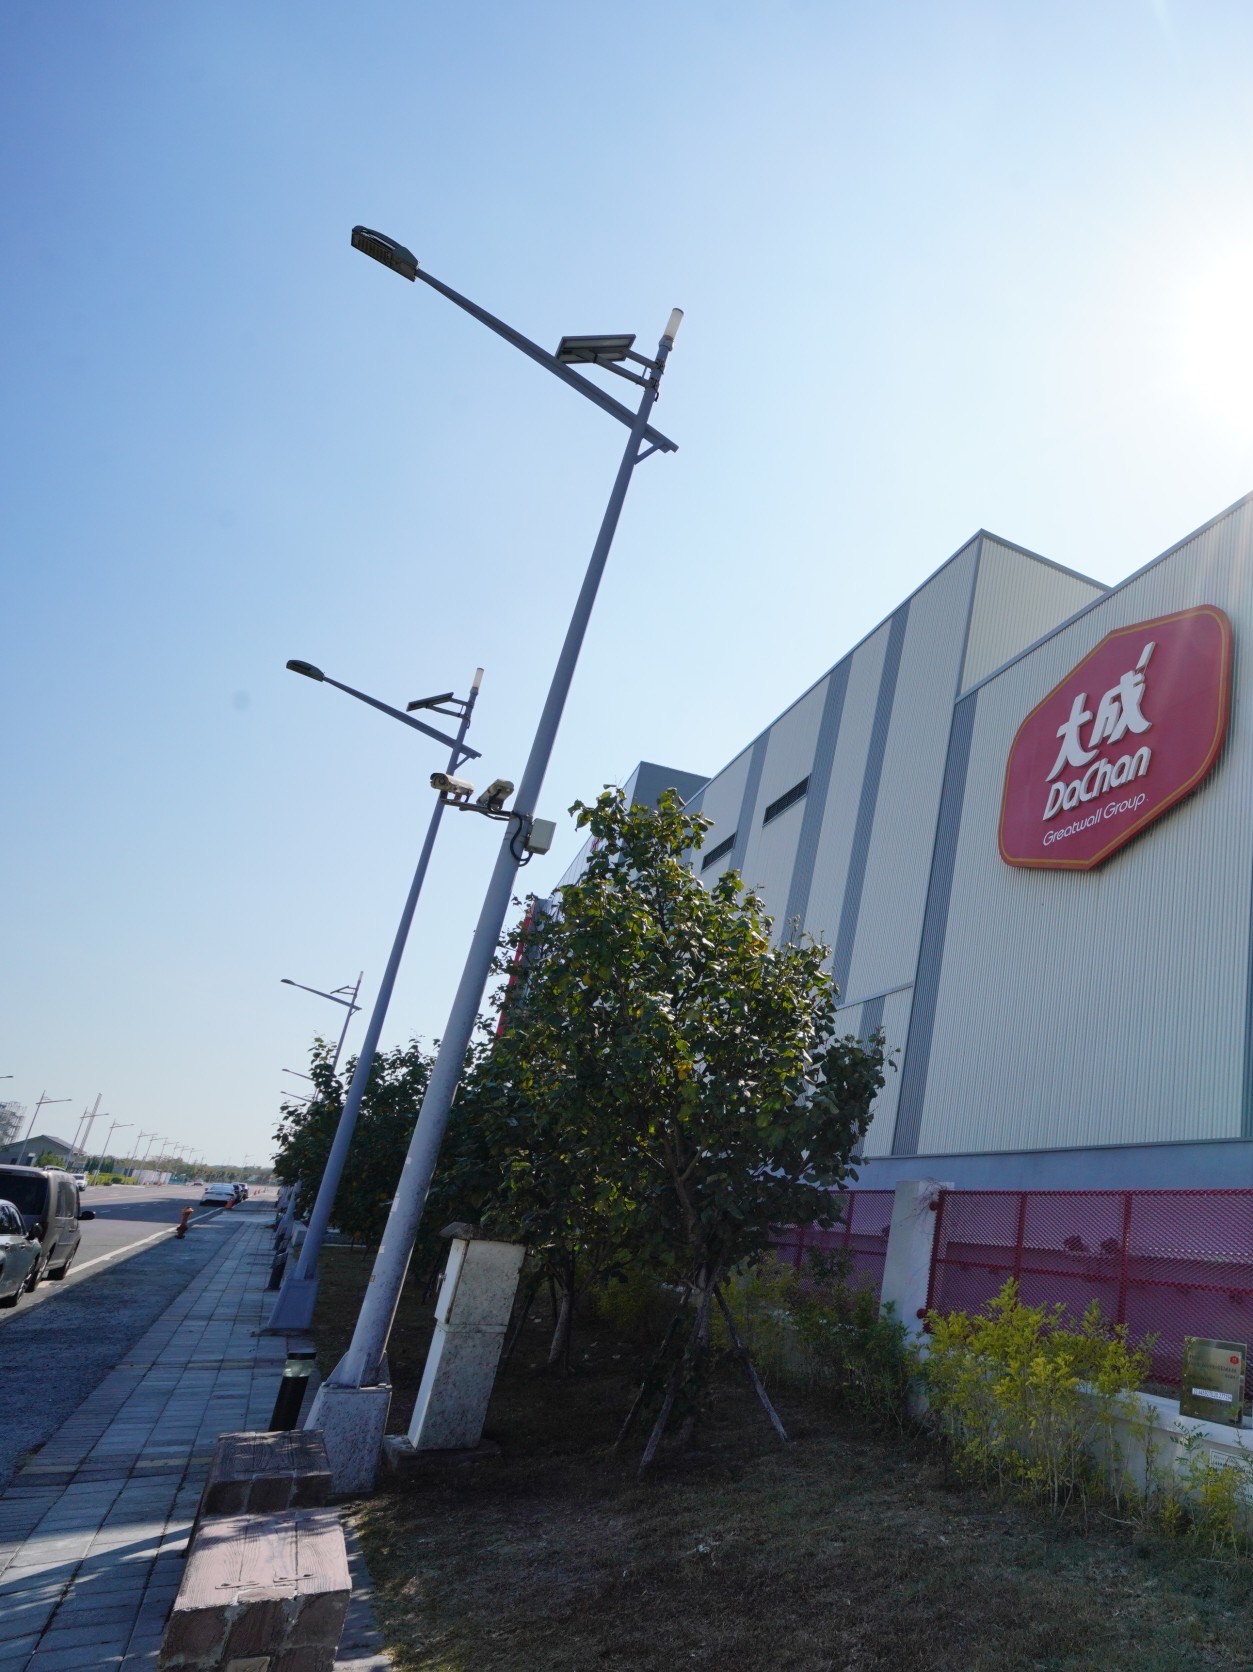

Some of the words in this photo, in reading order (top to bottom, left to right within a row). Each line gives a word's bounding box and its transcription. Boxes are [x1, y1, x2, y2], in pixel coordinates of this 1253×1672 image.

[1045, 641, 1156, 781] 大成
[1043, 746, 1152, 821] DaChan
[1043, 810, 1102, 847] Greatwall
[1103, 793, 1146, 819] Group
